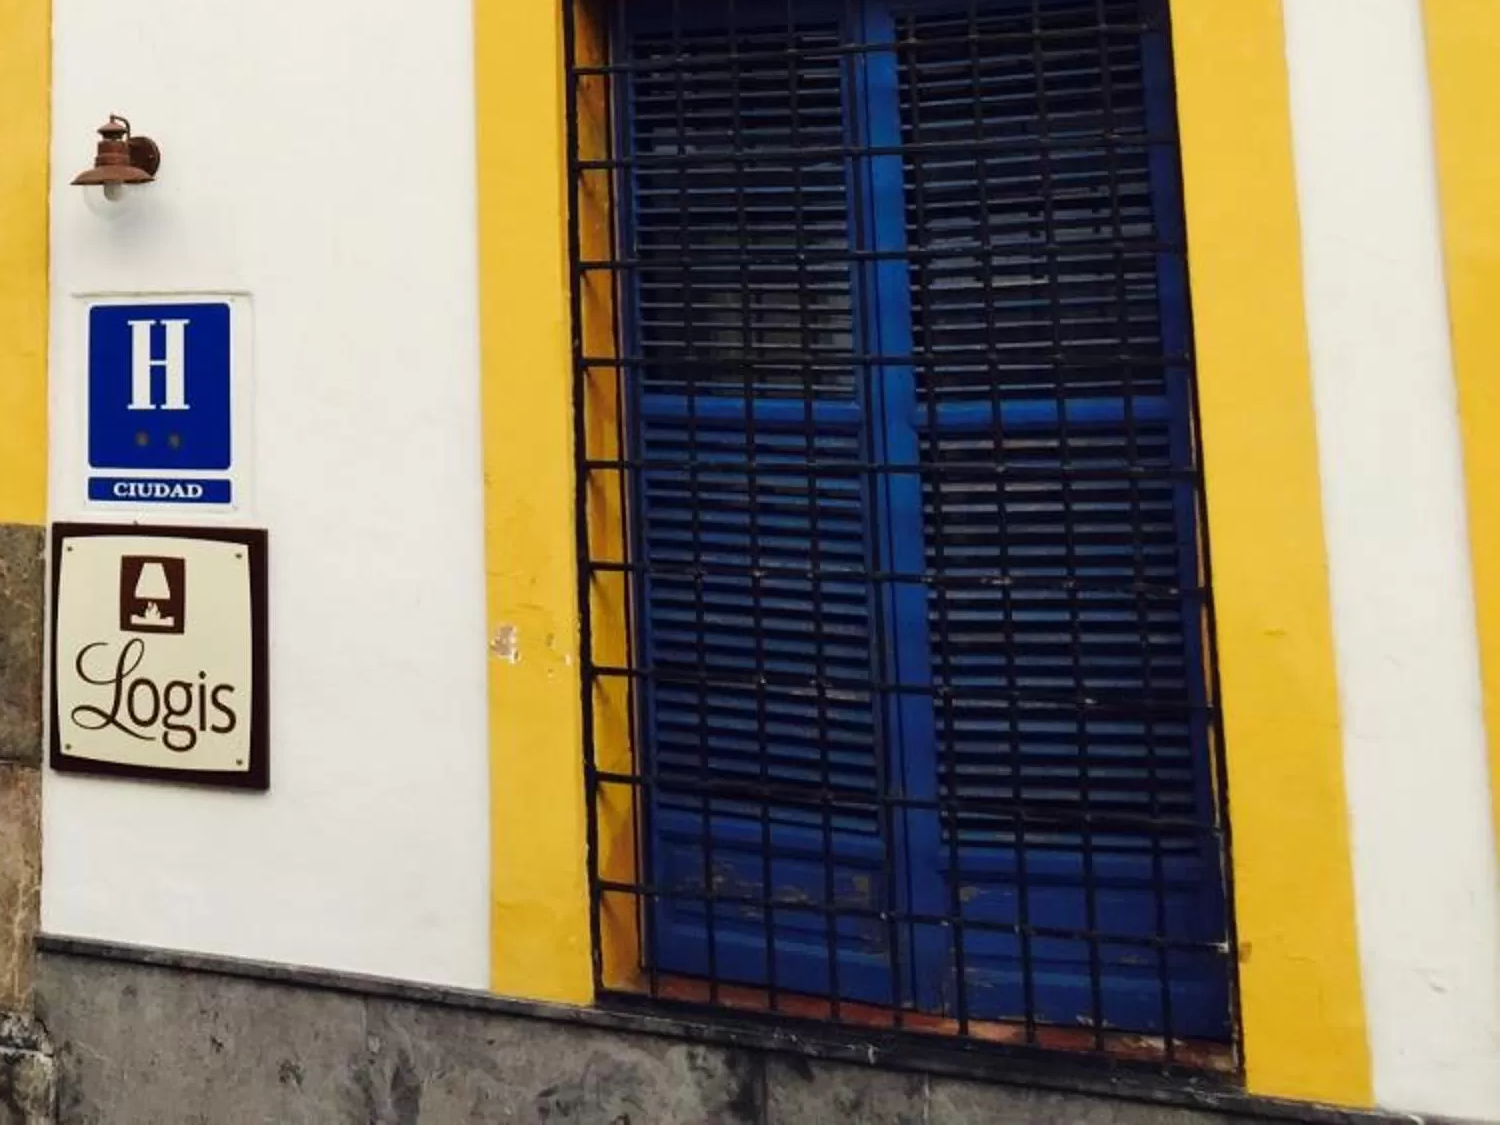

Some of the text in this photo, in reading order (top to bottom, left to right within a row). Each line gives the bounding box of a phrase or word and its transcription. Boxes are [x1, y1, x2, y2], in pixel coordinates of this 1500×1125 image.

[127, 318, 191, 410] H
[113, 481, 204, 499] CIUDAD
[71, 638, 238, 752] Logis
